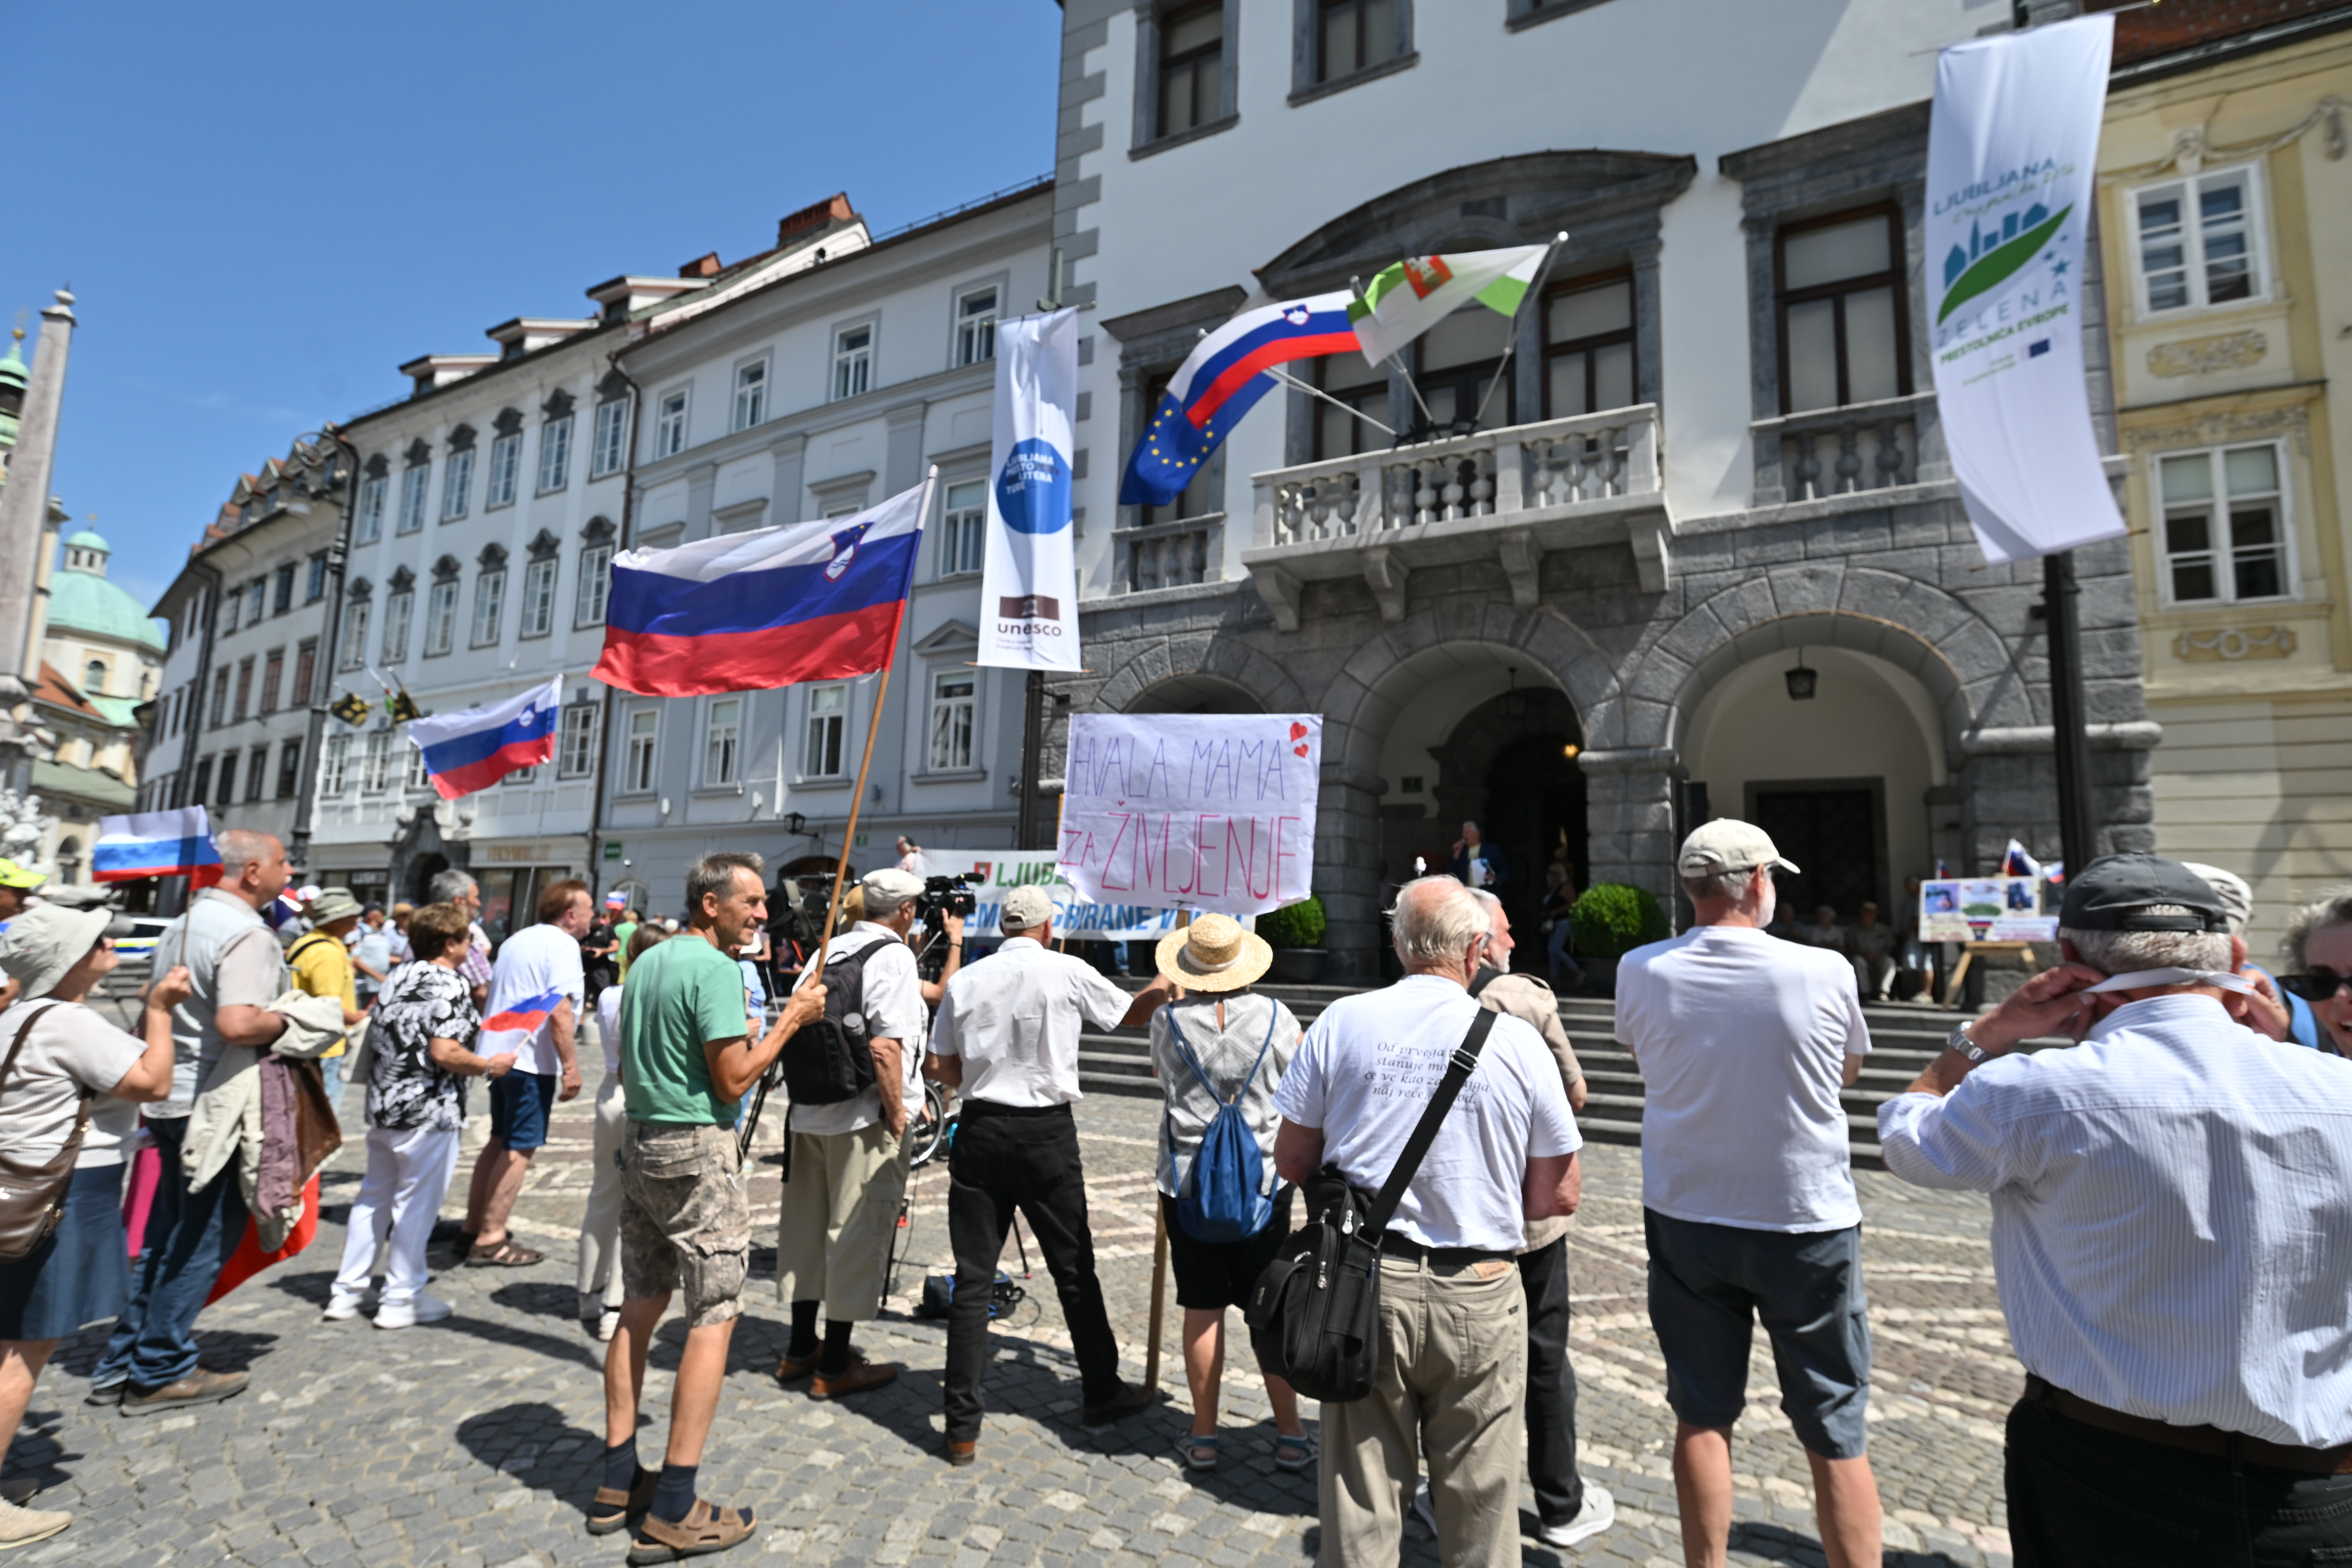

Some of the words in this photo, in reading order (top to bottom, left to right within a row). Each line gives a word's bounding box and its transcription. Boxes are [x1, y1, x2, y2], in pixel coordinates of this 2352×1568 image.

[1933, 158, 2055, 217] LJUBLJANA
[1937, 280, 2067, 348] ZELENA
[998, 623, 1061, 636] unesco
[1072, 732, 1169, 798] HVALA
[1187, 738, 1284, 800] MAMA
[1060, 830, 1097, 867] ZA
[1101, 800, 1300, 901] ŽIVLJENJE
[1378, 1042, 1398, 1053] Od
[1399, 1045, 1445, 1059] prvega
[1376, 1057, 1423, 1072] stanuje
[1365, 1071, 1377, 1081] če
[1382, 1073, 1396, 1082] ve
[1401, 1073, 1423, 1085] kdo
[1373, 1087, 1394, 1100] naj
[1399, 1088, 1427, 1101] reče,
